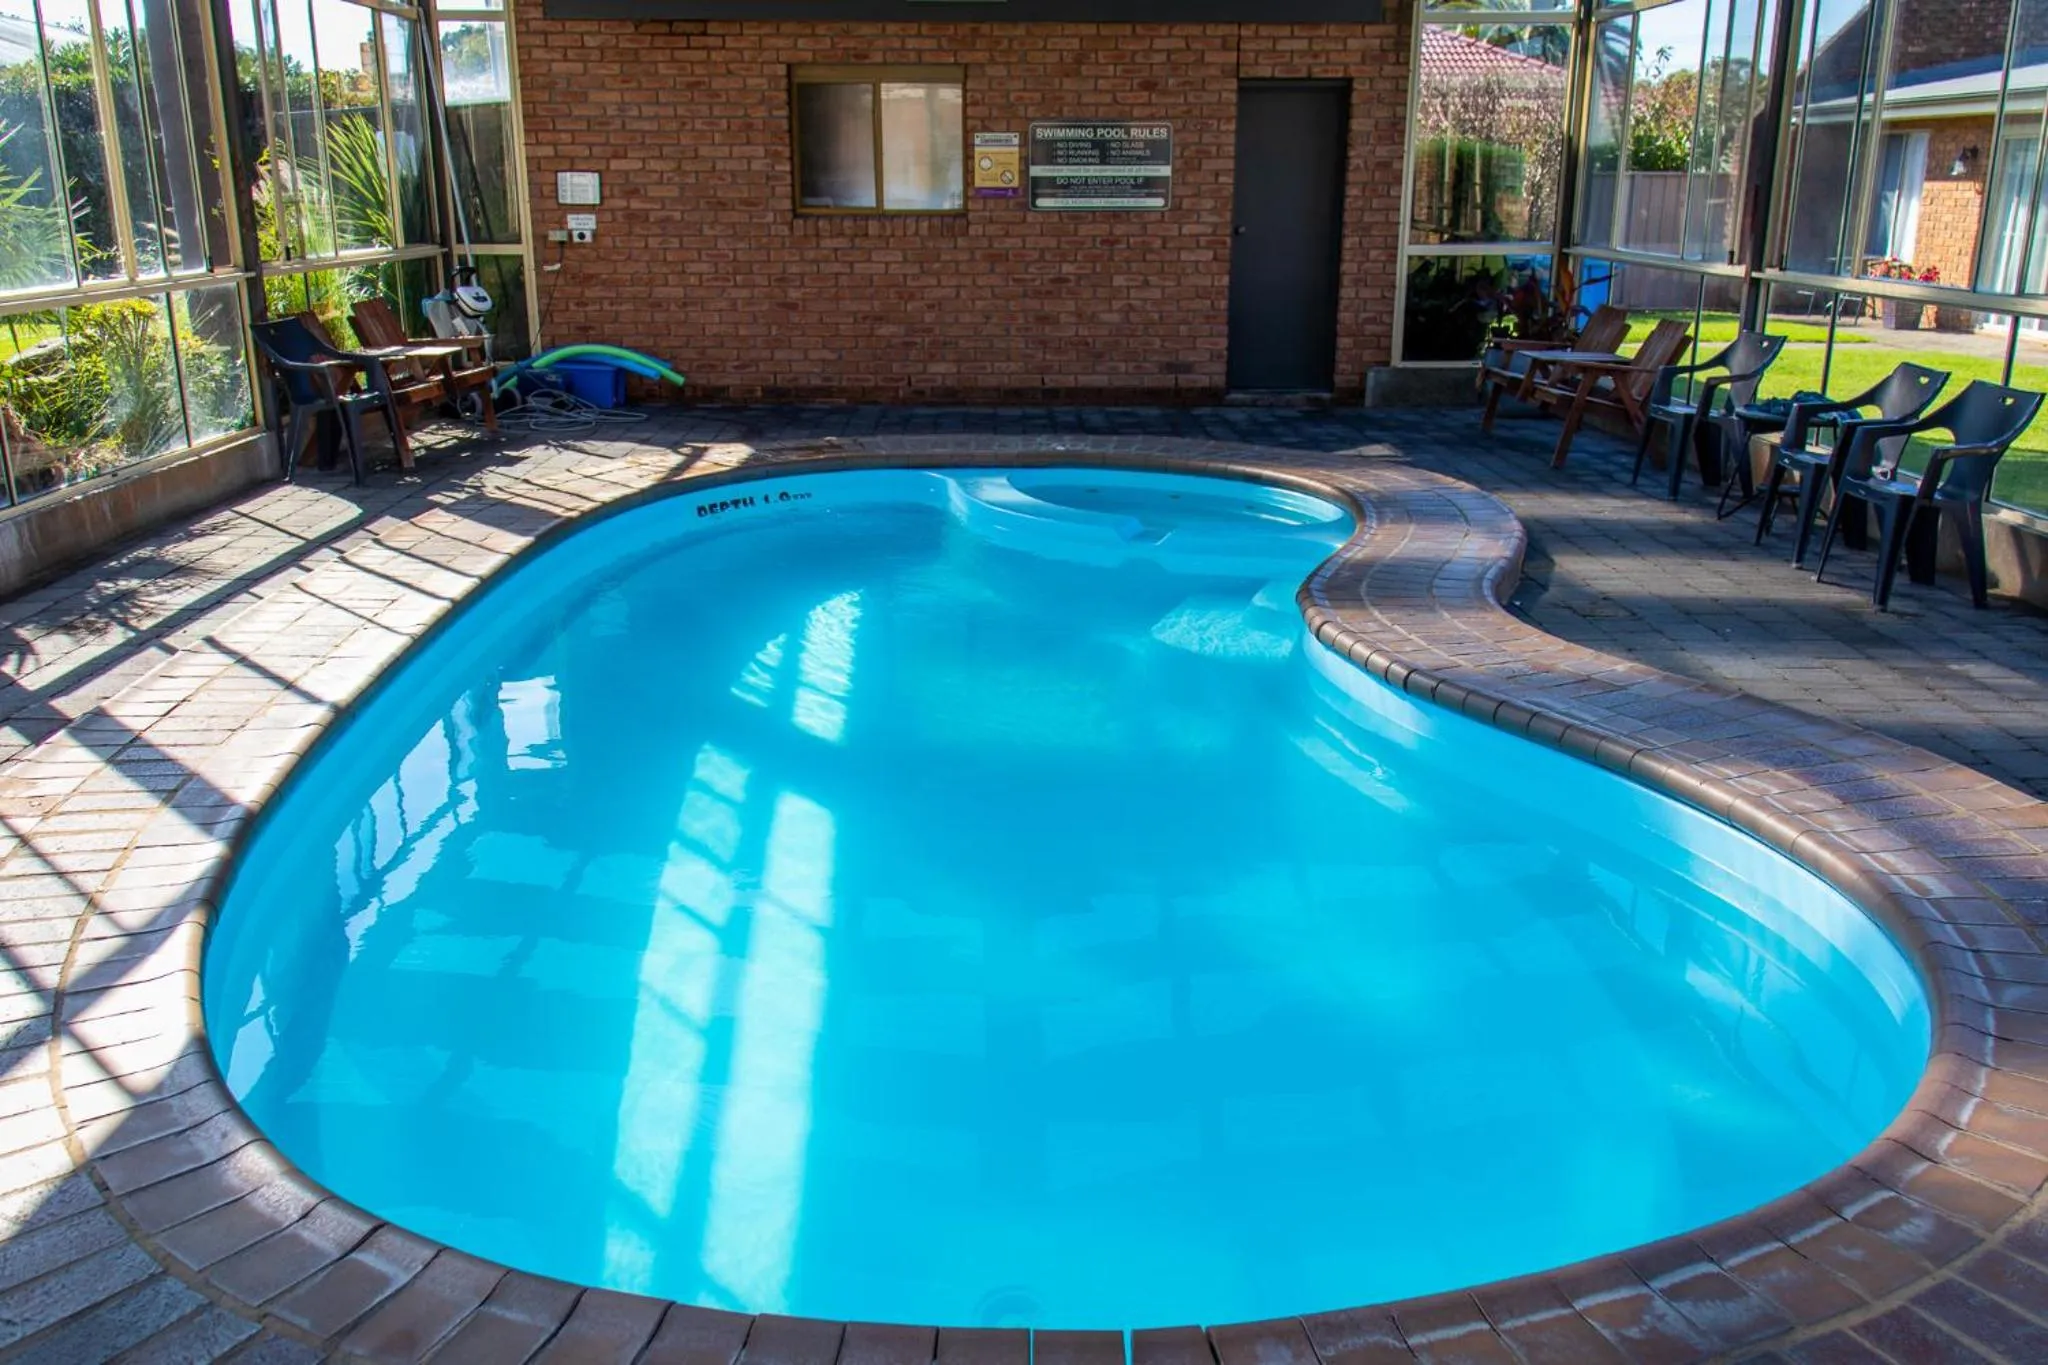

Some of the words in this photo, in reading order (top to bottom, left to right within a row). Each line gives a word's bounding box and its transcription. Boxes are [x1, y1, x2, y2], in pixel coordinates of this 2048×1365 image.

[1036, 128, 1094, 139] SWIMMING
[1097, 128, 1128, 139] POOL
[1130, 128, 1168, 139] RULES
[1056, 177, 1069, 185] DO
[1070, 177, 1085, 185] NOT
[1088, 177, 1113, 185] ENTER
[1115, 177, 1135, 185] POOL
[1137, 177, 1144, 185] IF
[697, 496, 756, 517] DEPTH
